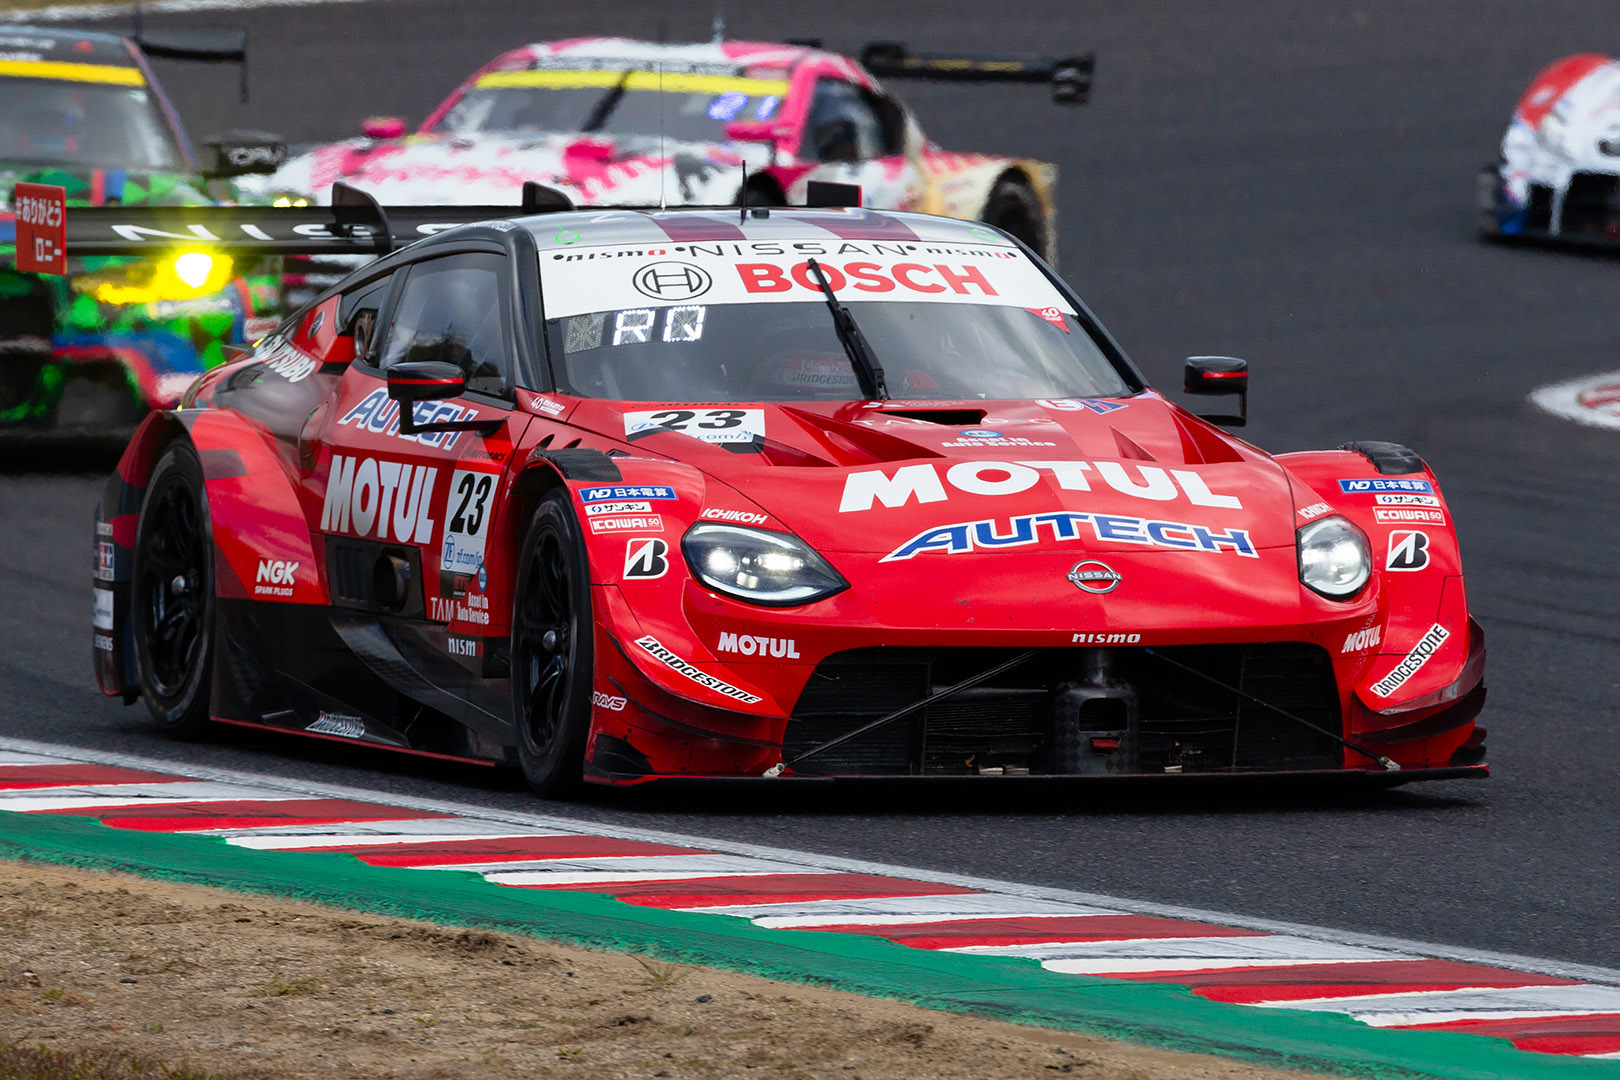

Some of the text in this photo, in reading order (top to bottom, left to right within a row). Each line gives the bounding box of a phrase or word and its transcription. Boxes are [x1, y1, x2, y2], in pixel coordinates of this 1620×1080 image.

[35, 238, 62, 262] ロニー
[688, 242, 902, 257] NISSAN
[735, 261, 999, 297] BOSCH
[337, 386, 480, 451] AUECH
[650, 410, 747, 430] 23
[320, 455, 438, 544] MOTUL
[839, 461, 1243, 513] MOTUL
[449, 473, 492, 536] 23
[604, 504, 645, 512] サンキン
[701, 508, 768, 525] ICHIKOH
[592, 518, 660, 530] KOIWAI 50
[879, 511, 1259, 563] AUTECH
[256, 560, 299, 586] NGK
[1069, 571, 1119, 580] NISSAN
[717, 631, 800, 659] MOTUL
[1072, 633, 1141, 644] nismo
[1342, 625, 1381, 653] MOTUL
[636, 636, 761, 704] BRIDGESTONE
[1371, 625, 1447, 697] BRIDGESTONE
